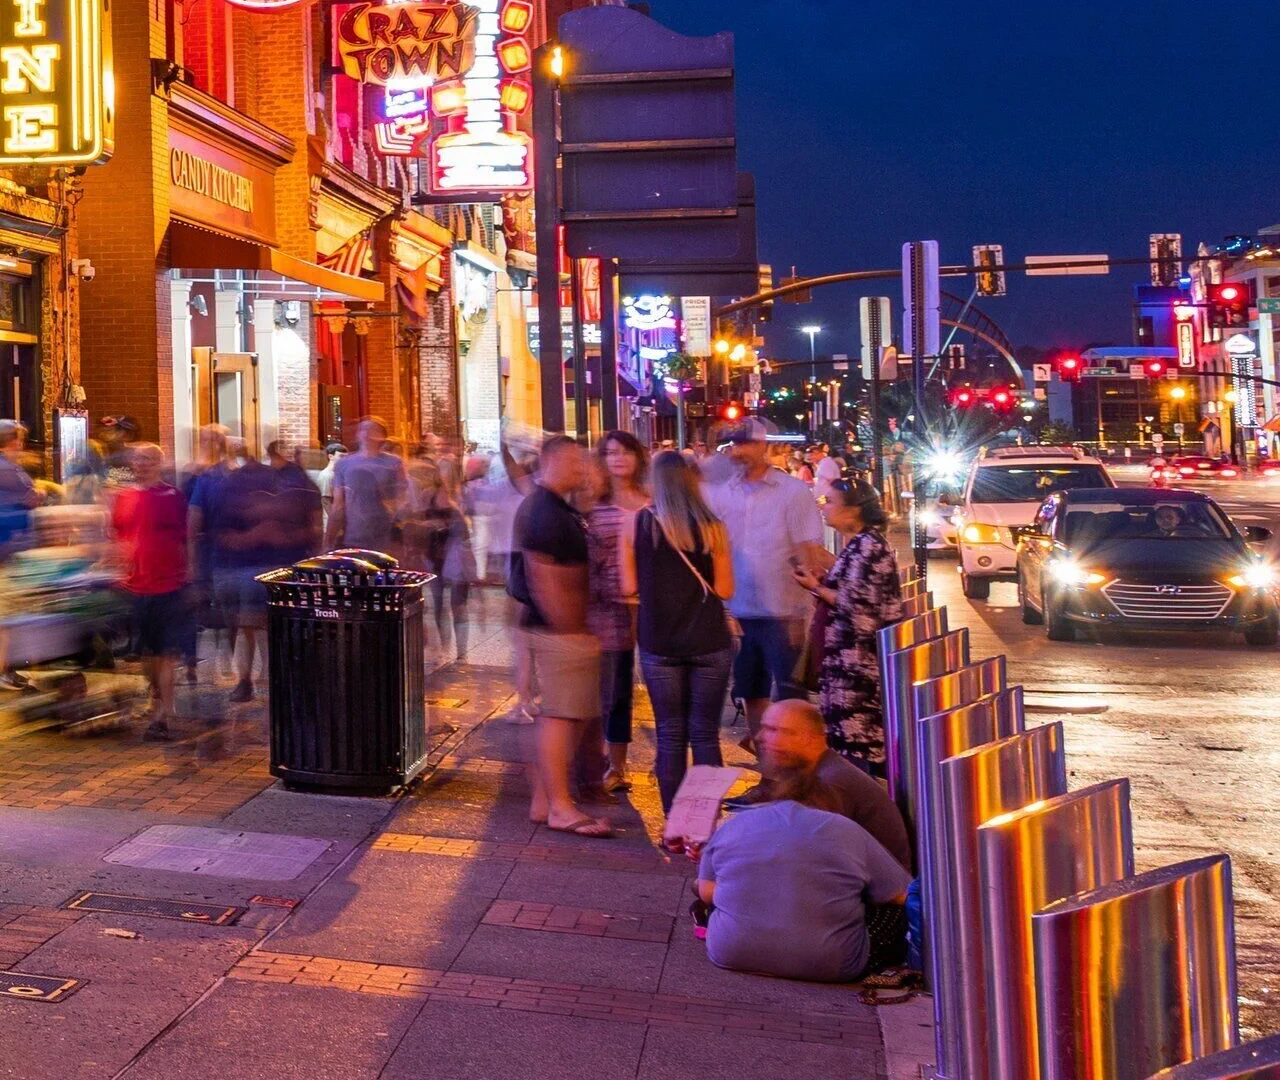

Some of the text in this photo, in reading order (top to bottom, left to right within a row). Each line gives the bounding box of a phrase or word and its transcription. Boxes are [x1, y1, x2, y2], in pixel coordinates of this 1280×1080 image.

[339, 2, 480, 46] CRAZY
[346, 39, 465, 84] TOWN
[171, 148, 254, 213] CANDY KITCHEN
[314, 609, 339, 618] Trash
